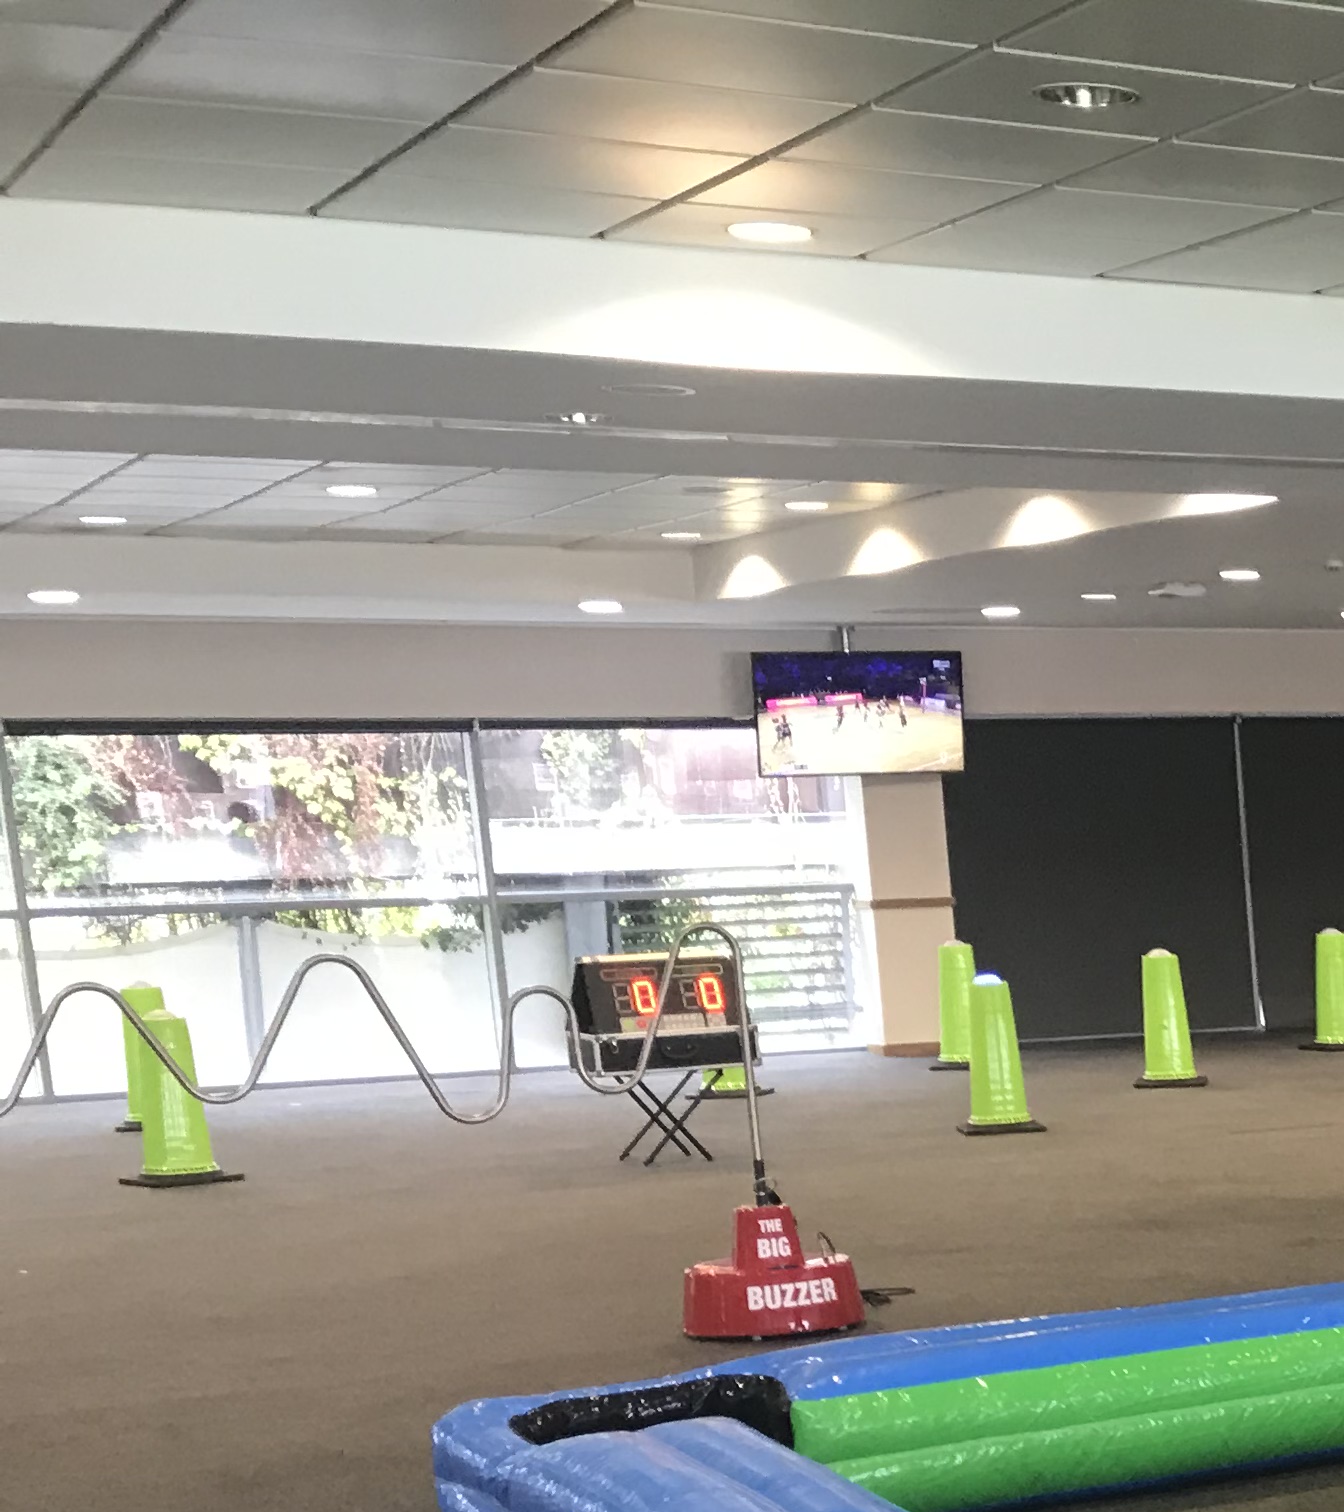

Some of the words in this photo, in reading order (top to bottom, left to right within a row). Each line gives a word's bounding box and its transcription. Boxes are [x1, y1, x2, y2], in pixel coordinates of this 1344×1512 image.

[757, 1218, 784, 1234] THE
[757, 1237, 792, 1259] BIG
[746, 1277, 838, 1312] BUZZER
